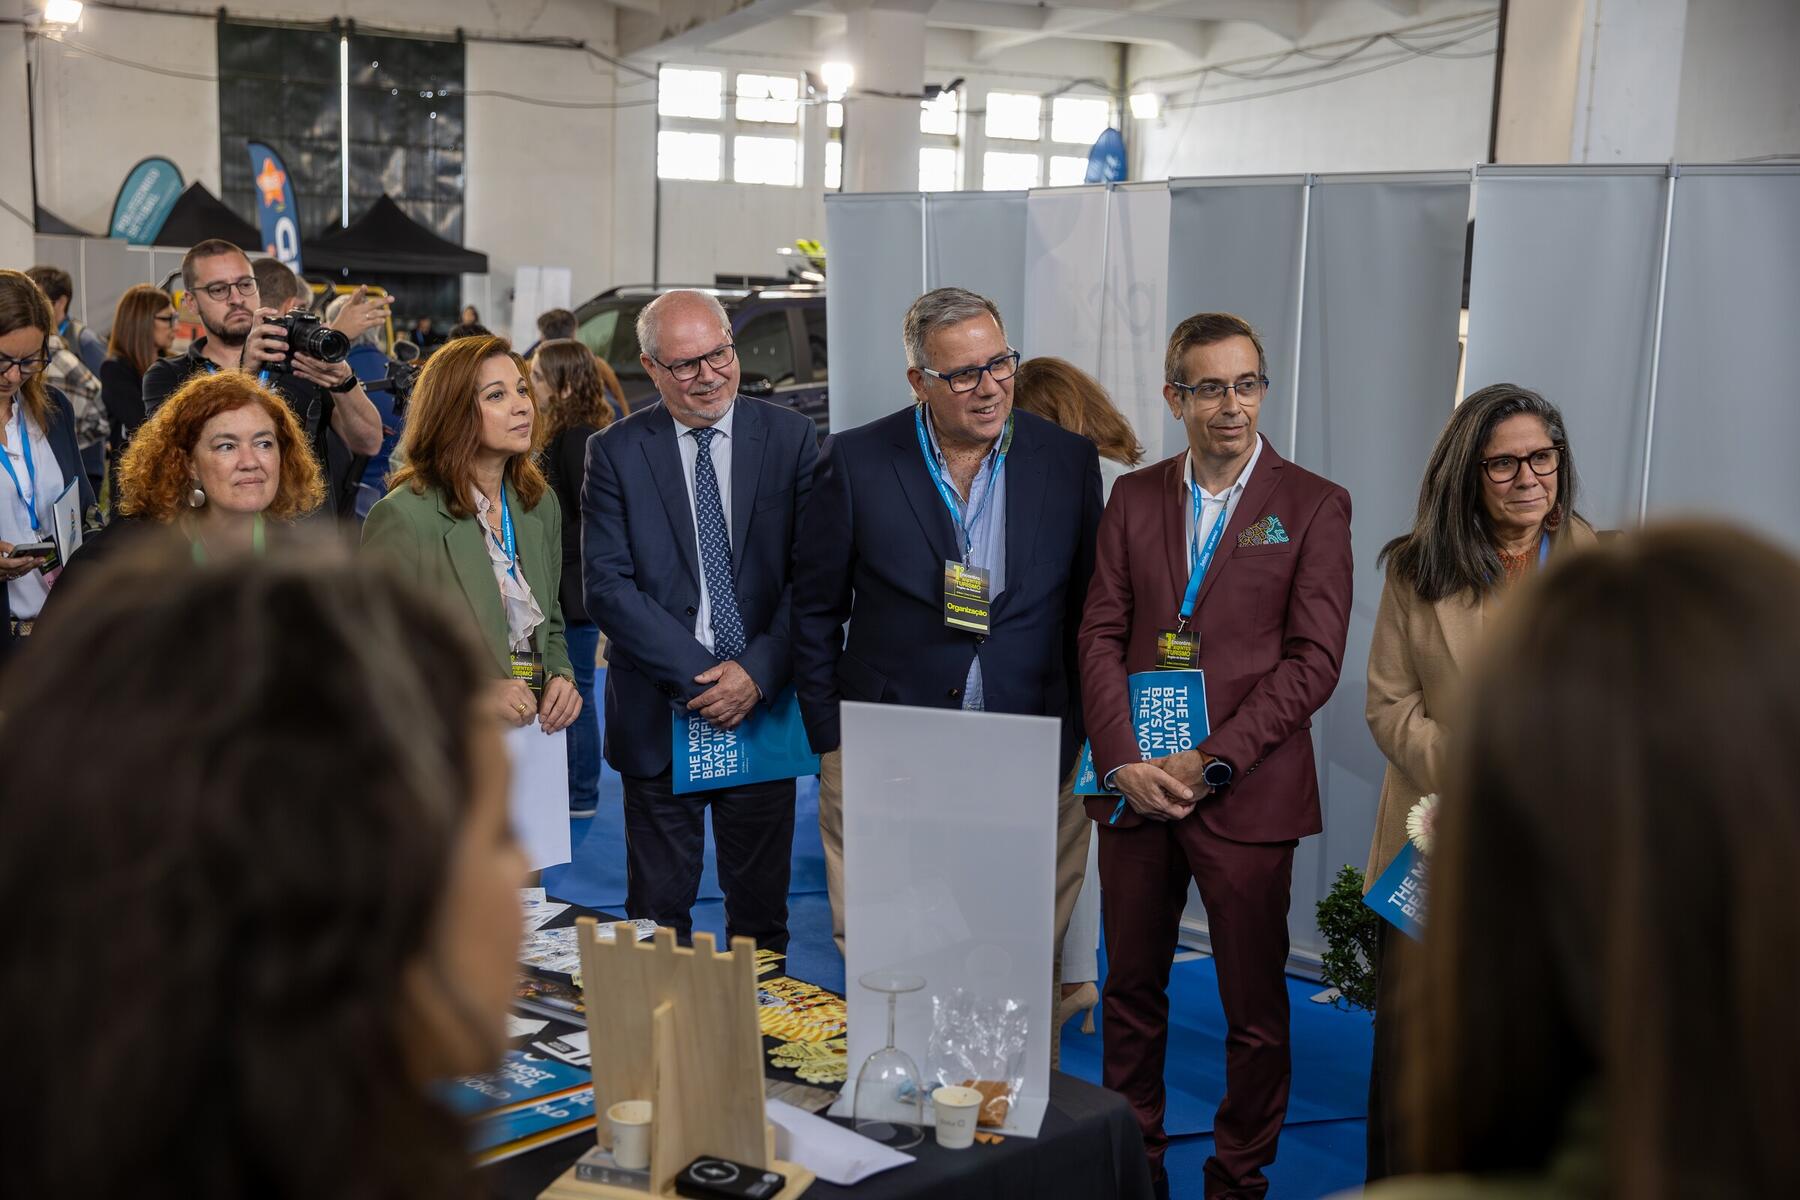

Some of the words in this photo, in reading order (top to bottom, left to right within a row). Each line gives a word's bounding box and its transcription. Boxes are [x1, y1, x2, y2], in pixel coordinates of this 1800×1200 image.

[947, 602, 988, 617] Organização
[1139, 687, 1151, 719] THE
[1151, 687, 1163, 728] BAYS
[1176, 686, 1189, 718] THE
[688, 716, 701, 753] MOST
[713, 727, 724, 741] IN
[1163, 687, 1179, 754] BEAUTIF
[701, 717, 713, 779] BEAUTIF
[1138, 722, 1152, 761] WOR
[1151, 732, 1164, 749] IN
[1177, 722, 1192, 751] MO
[689, 754, 701, 782] THE
[713, 743, 726, 778] BAYS
[726, 749, 738, 776] THE
[1388, 876, 1418, 907] THE
[506, 1062, 556, 1080] MOST
[460, 1078, 511, 1099] ORLD
